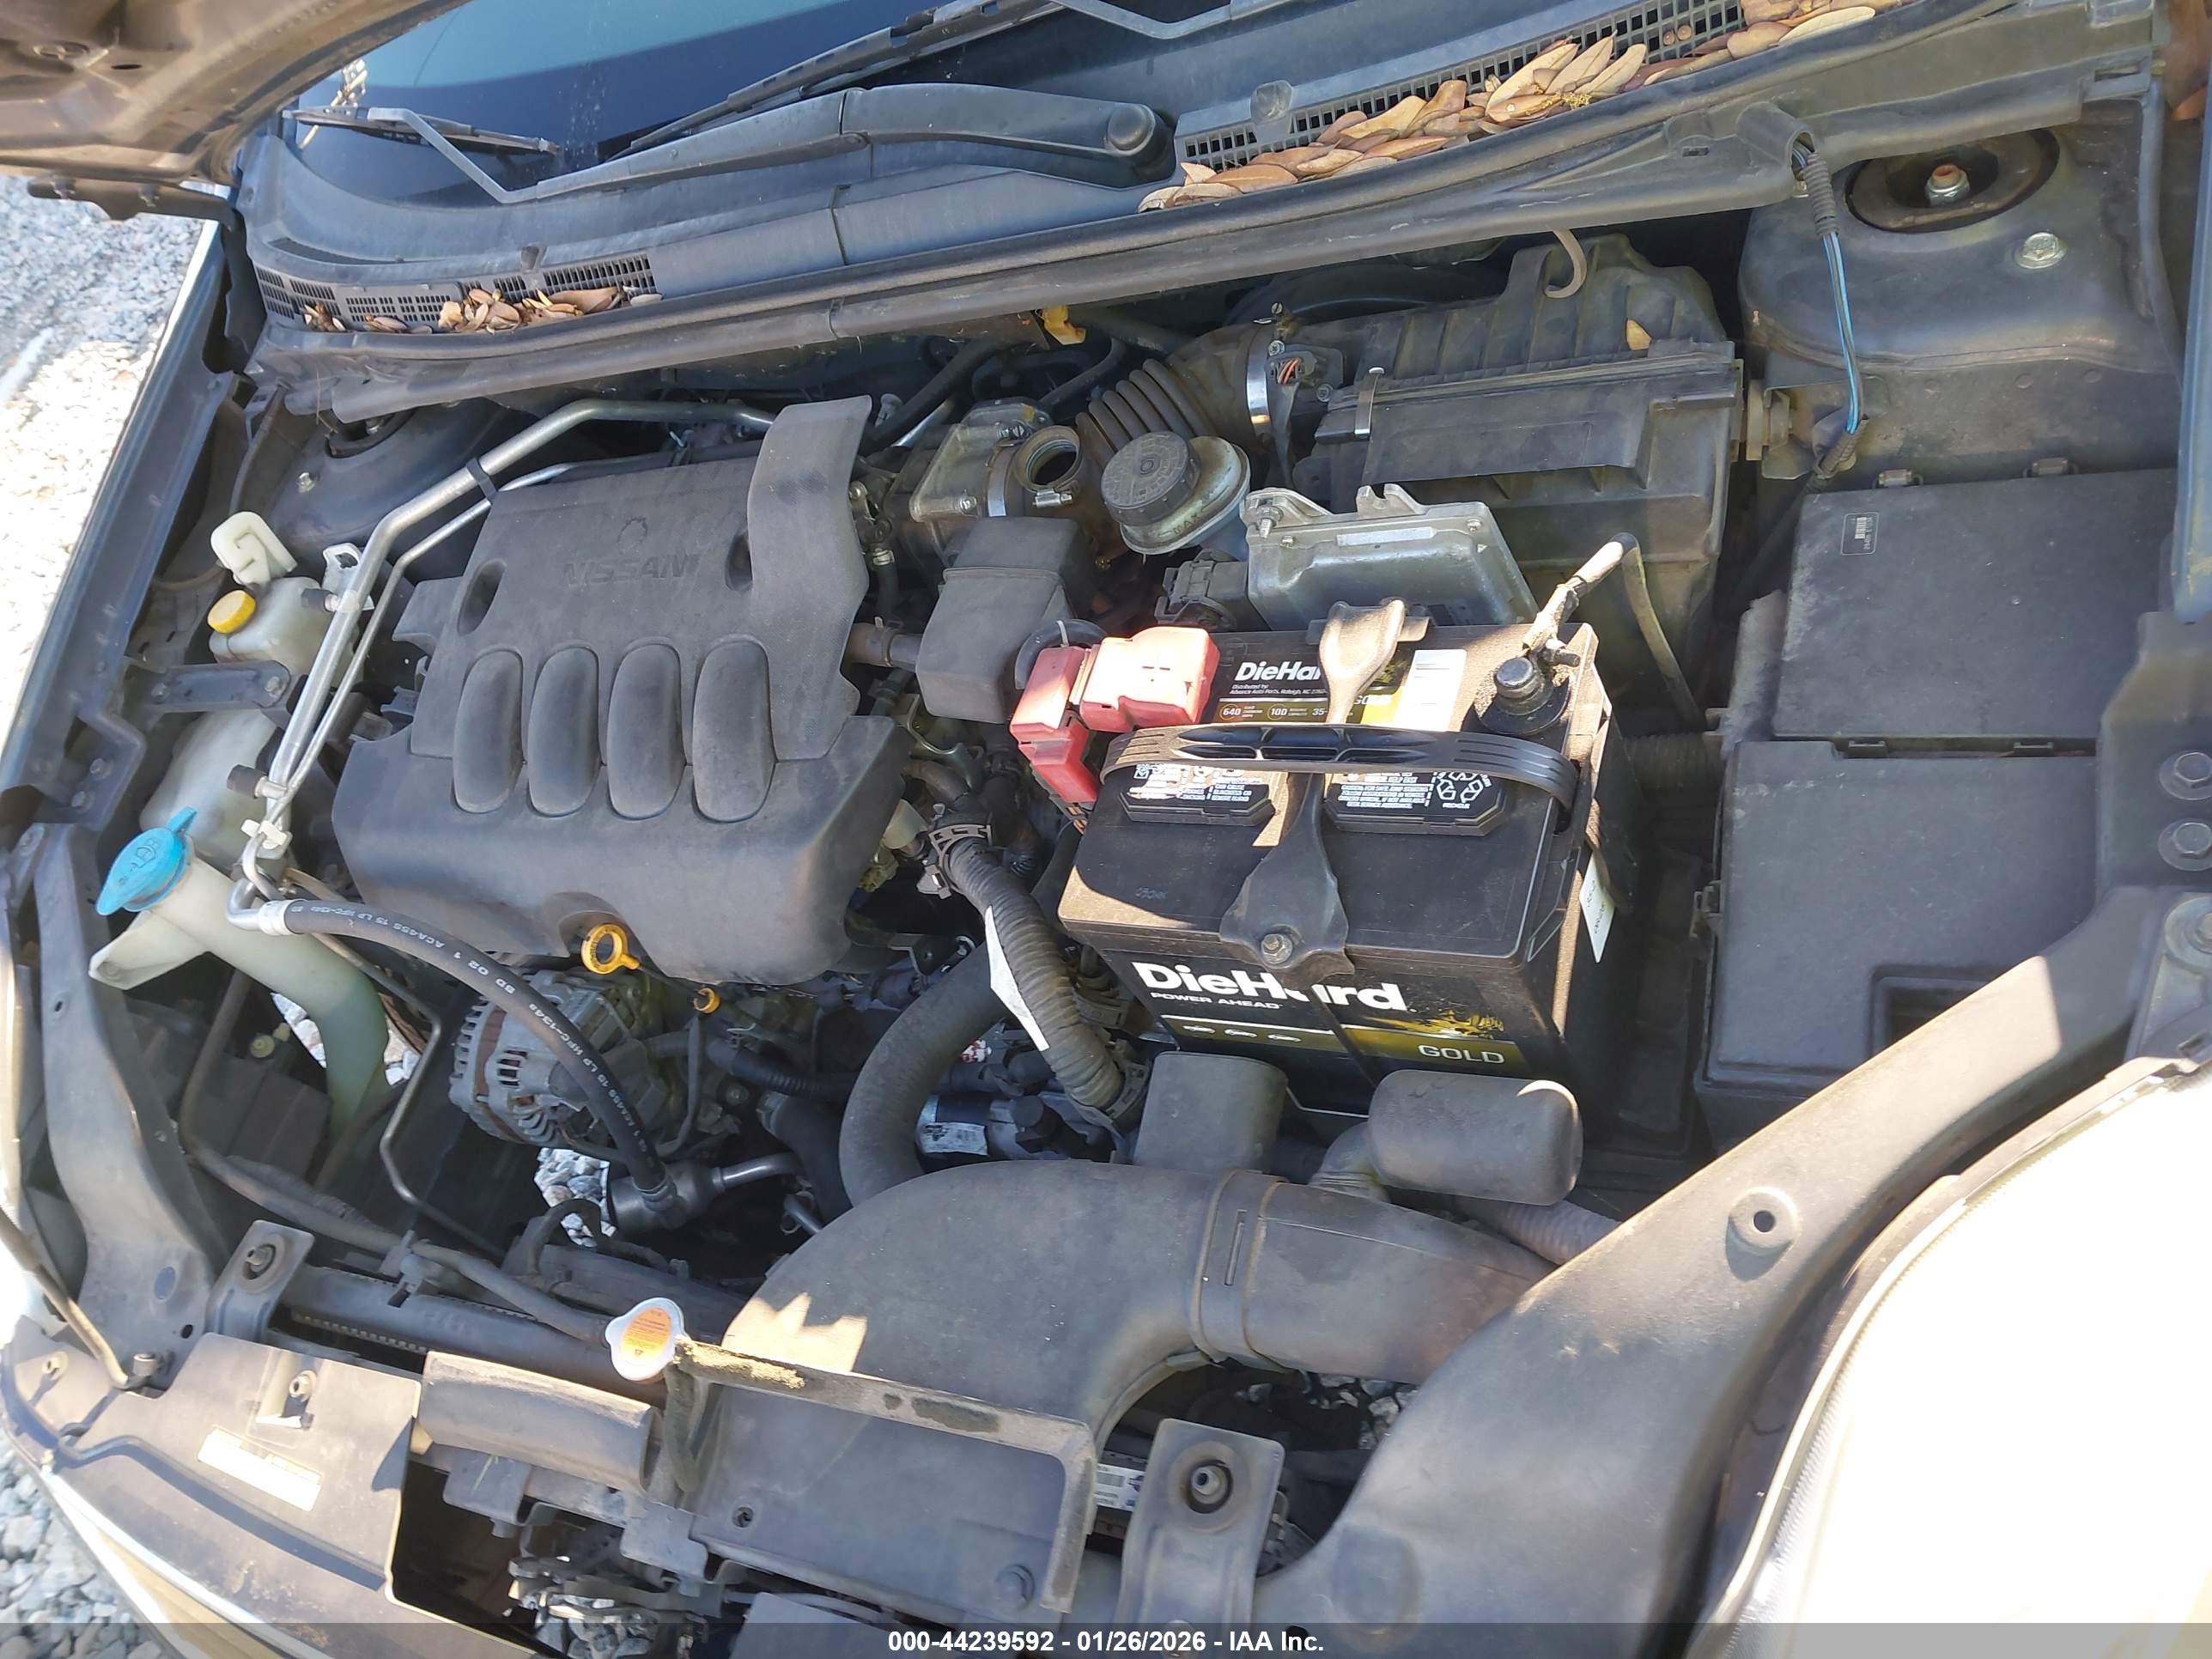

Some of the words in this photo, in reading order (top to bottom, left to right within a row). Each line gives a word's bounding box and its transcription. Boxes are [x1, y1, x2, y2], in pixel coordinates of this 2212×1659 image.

[563, 554, 700, 586] NISSAN
[467, 960, 489, 975] 02
[1151, 993, 1212, 1003] POWER
[1218, 998, 1279, 1009] AHEAD
[1417, 1043, 1506, 1066] GOLD
